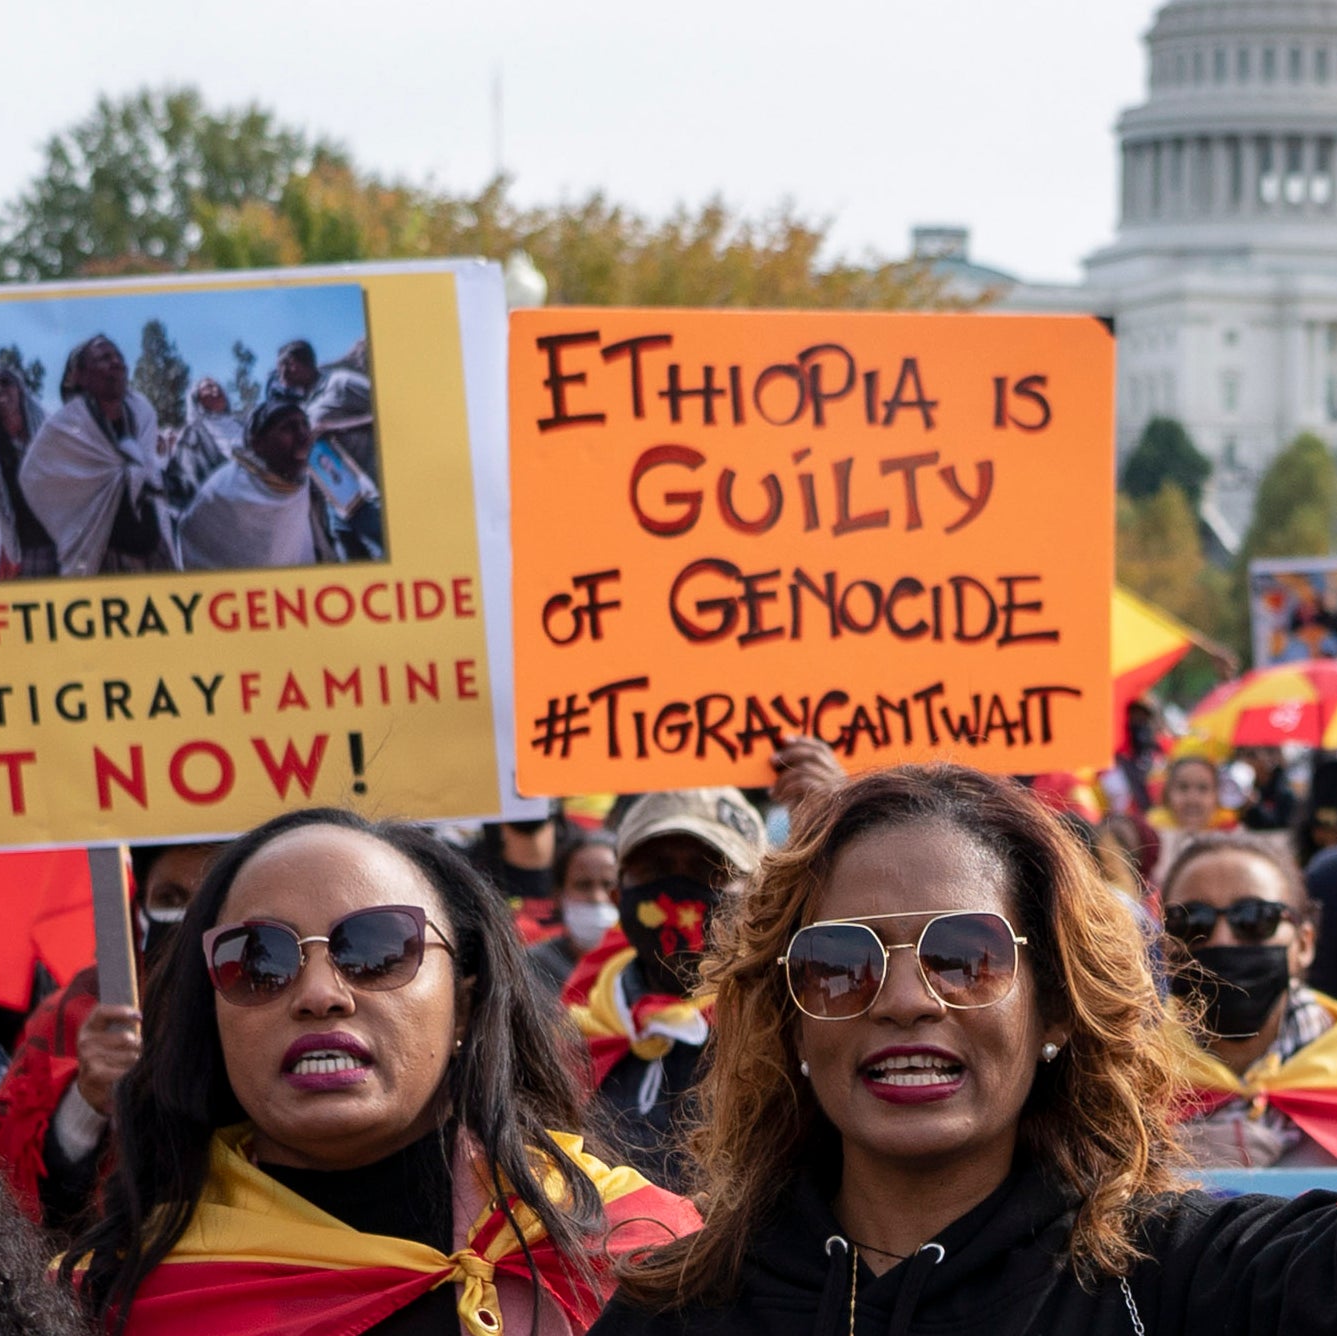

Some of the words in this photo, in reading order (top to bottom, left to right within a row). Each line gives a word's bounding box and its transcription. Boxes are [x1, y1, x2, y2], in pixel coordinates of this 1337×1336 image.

[536, 331, 939, 432] ETHIOPIA
[993, 374, 1052, 432] IS
[668, 557, 1060, 647] GENOCIDE
[93, 732, 368, 812] NOW!
